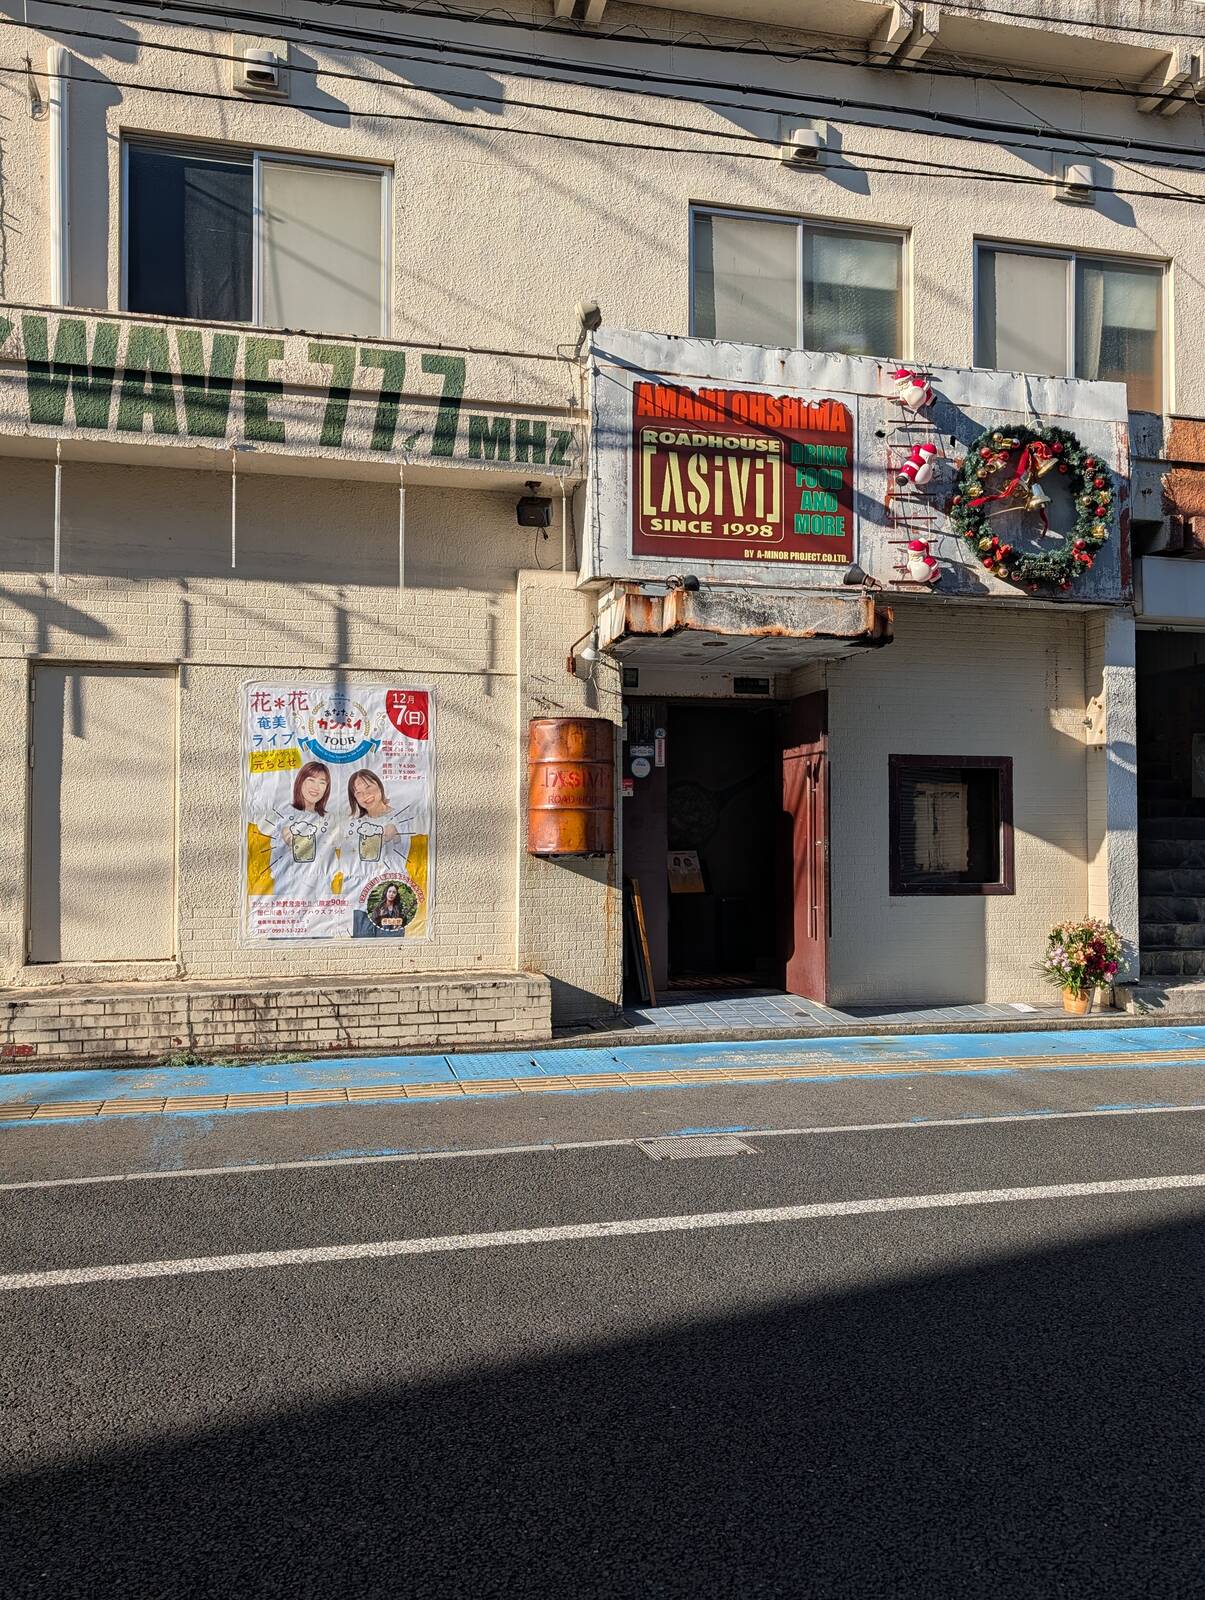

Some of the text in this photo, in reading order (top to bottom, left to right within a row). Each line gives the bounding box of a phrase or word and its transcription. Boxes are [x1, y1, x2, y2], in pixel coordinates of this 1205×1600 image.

[21, 315, 286, 443] WAVE
[637, 384, 847, 433] AMAMI OHSHIMA
[643, 429, 781, 453] ROADHOUSE
[791, 442, 848, 468] DRINK
[795, 467, 843, 490] FOOD
[800, 490, 839, 513] AND
[650, 518, 774, 538] SINCE 1998
[793, 513, 846, 537] MORE
[744, 549, 754, 559] BY
[756, 549, 789, 560] A-MINOR
[393, 693, 415, 704] 12月
[257, 715, 287, 730] 奄美
[317, 718, 362, 730] カンパイ
[324, 736, 356, 746] TOUR
[253, 758, 297, 770] 元ちとせ
